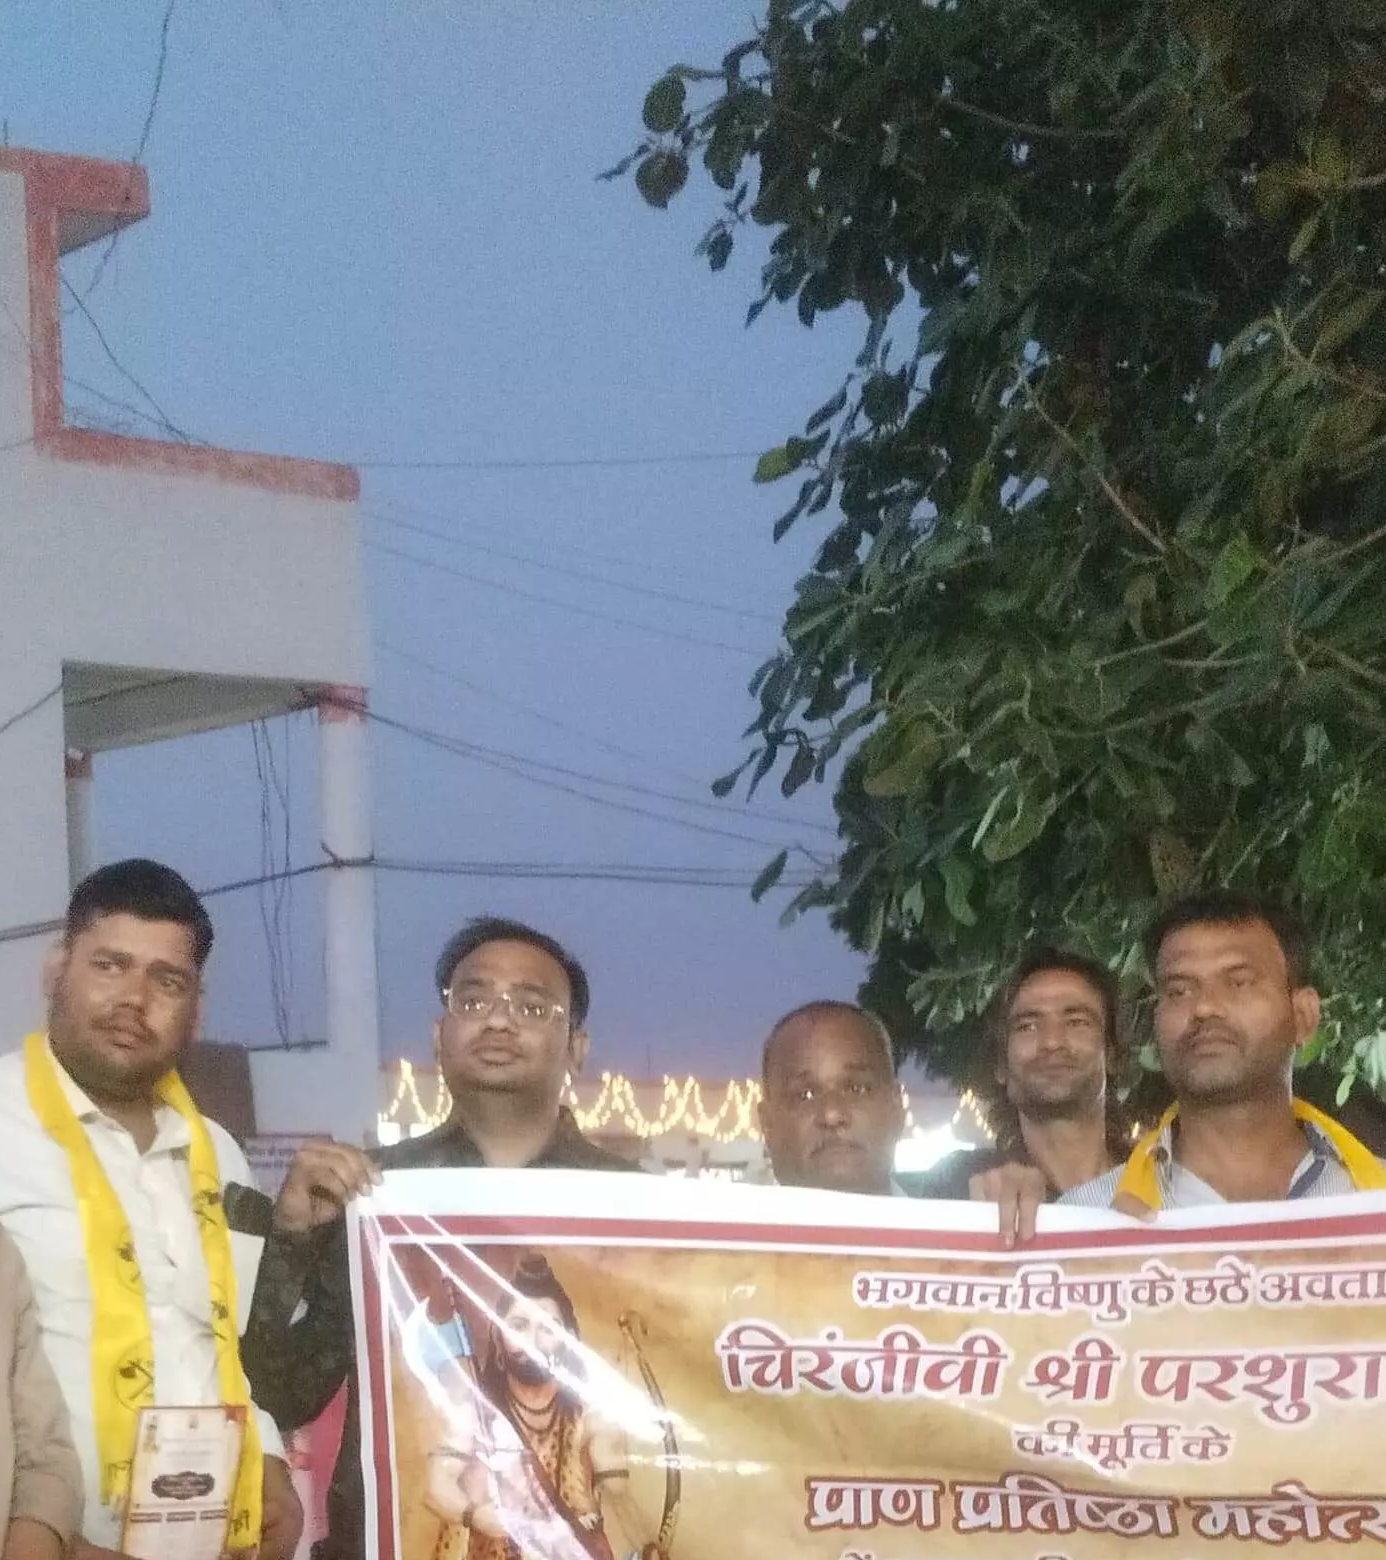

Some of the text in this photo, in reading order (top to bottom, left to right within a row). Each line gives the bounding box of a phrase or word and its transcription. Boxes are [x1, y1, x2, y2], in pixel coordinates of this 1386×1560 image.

[856, 1276, 1012, 1309] भगवान
[1018, 1270, 1127, 1322] विष्णु
[1131, 1264, 1175, 1308] के
[1183, 1262, 1252, 1305] छठे
[721, 1325, 1008, 1396] चिरंजीवी
[1025, 1337, 1120, 1400] श्री
[1015, 1419, 1232, 1469] की मूर्ति के
[807, 1476, 944, 1531] प्राण
[951, 1472, 1180, 1537] प्रतिष्ठा
